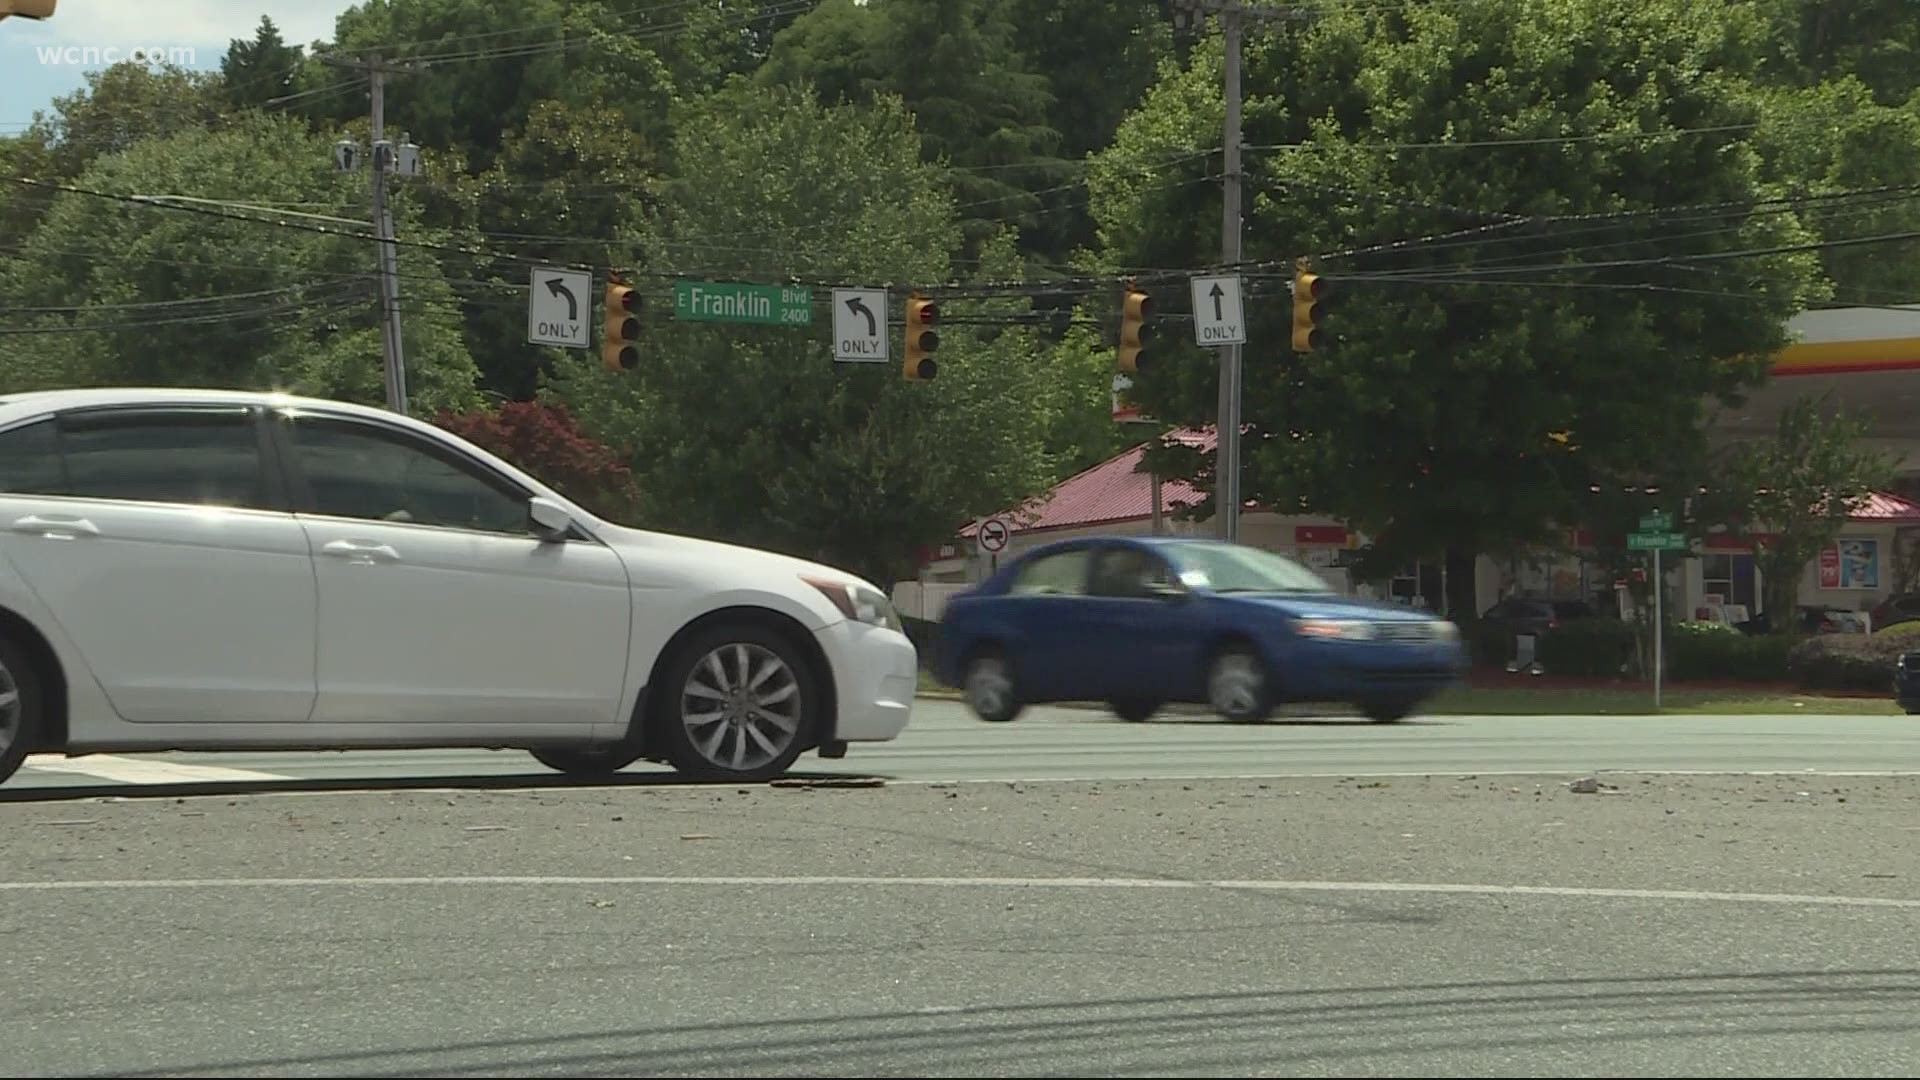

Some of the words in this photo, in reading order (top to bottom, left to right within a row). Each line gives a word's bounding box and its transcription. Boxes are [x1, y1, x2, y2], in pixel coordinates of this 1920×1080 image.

[678, 293, 686, 307] E
[691, 288, 770, 318] Franklin
[781, 289, 807, 304] Blvd
[781, 308, 809, 323] 2400
[538, 322, 580, 339] ONLY
[1204, 326, 1237, 340] ONLY
[842, 340, 880, 354] ONLY
